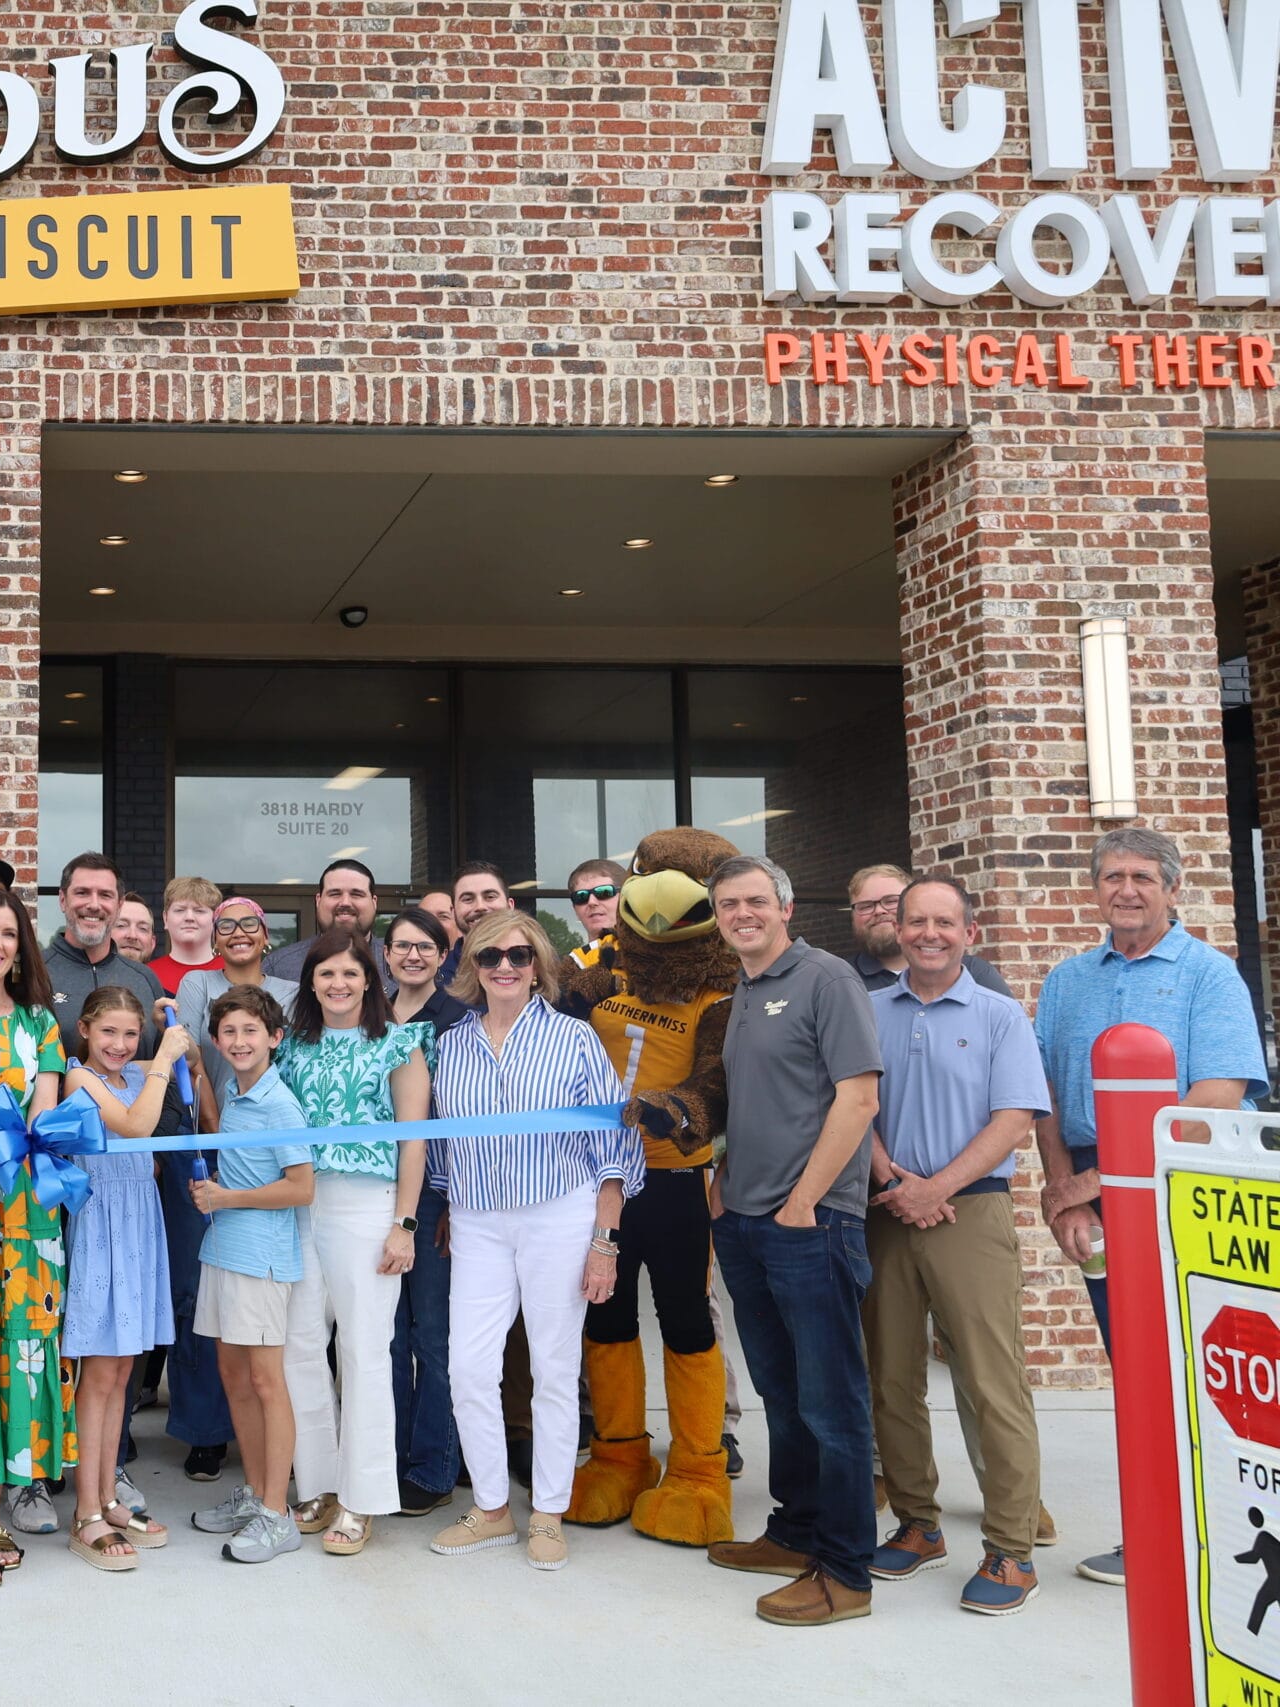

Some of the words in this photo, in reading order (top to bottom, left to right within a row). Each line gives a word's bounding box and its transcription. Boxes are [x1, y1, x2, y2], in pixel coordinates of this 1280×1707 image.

[762, 191, 1280, 307] RECOVE
[764, 331, 1090, 388] PHYSICAL
[1109, 333, 1277, 389] THER
[260, 802, 299, 816] 3818
[303, 802, 365, 816] HARDY
[277, 822, 326, 835] SUITE
[331, 822, 349, 835] 20
[597, 999, 658, 1025] SOUTHERN
[657, 1015, 688, 1034] MISS
[1192, 1186, 1280, 1231] STATE
[1207, 1231, 1270, 1275] LAW
[1240, 1676, 1280, 1707] WIT
